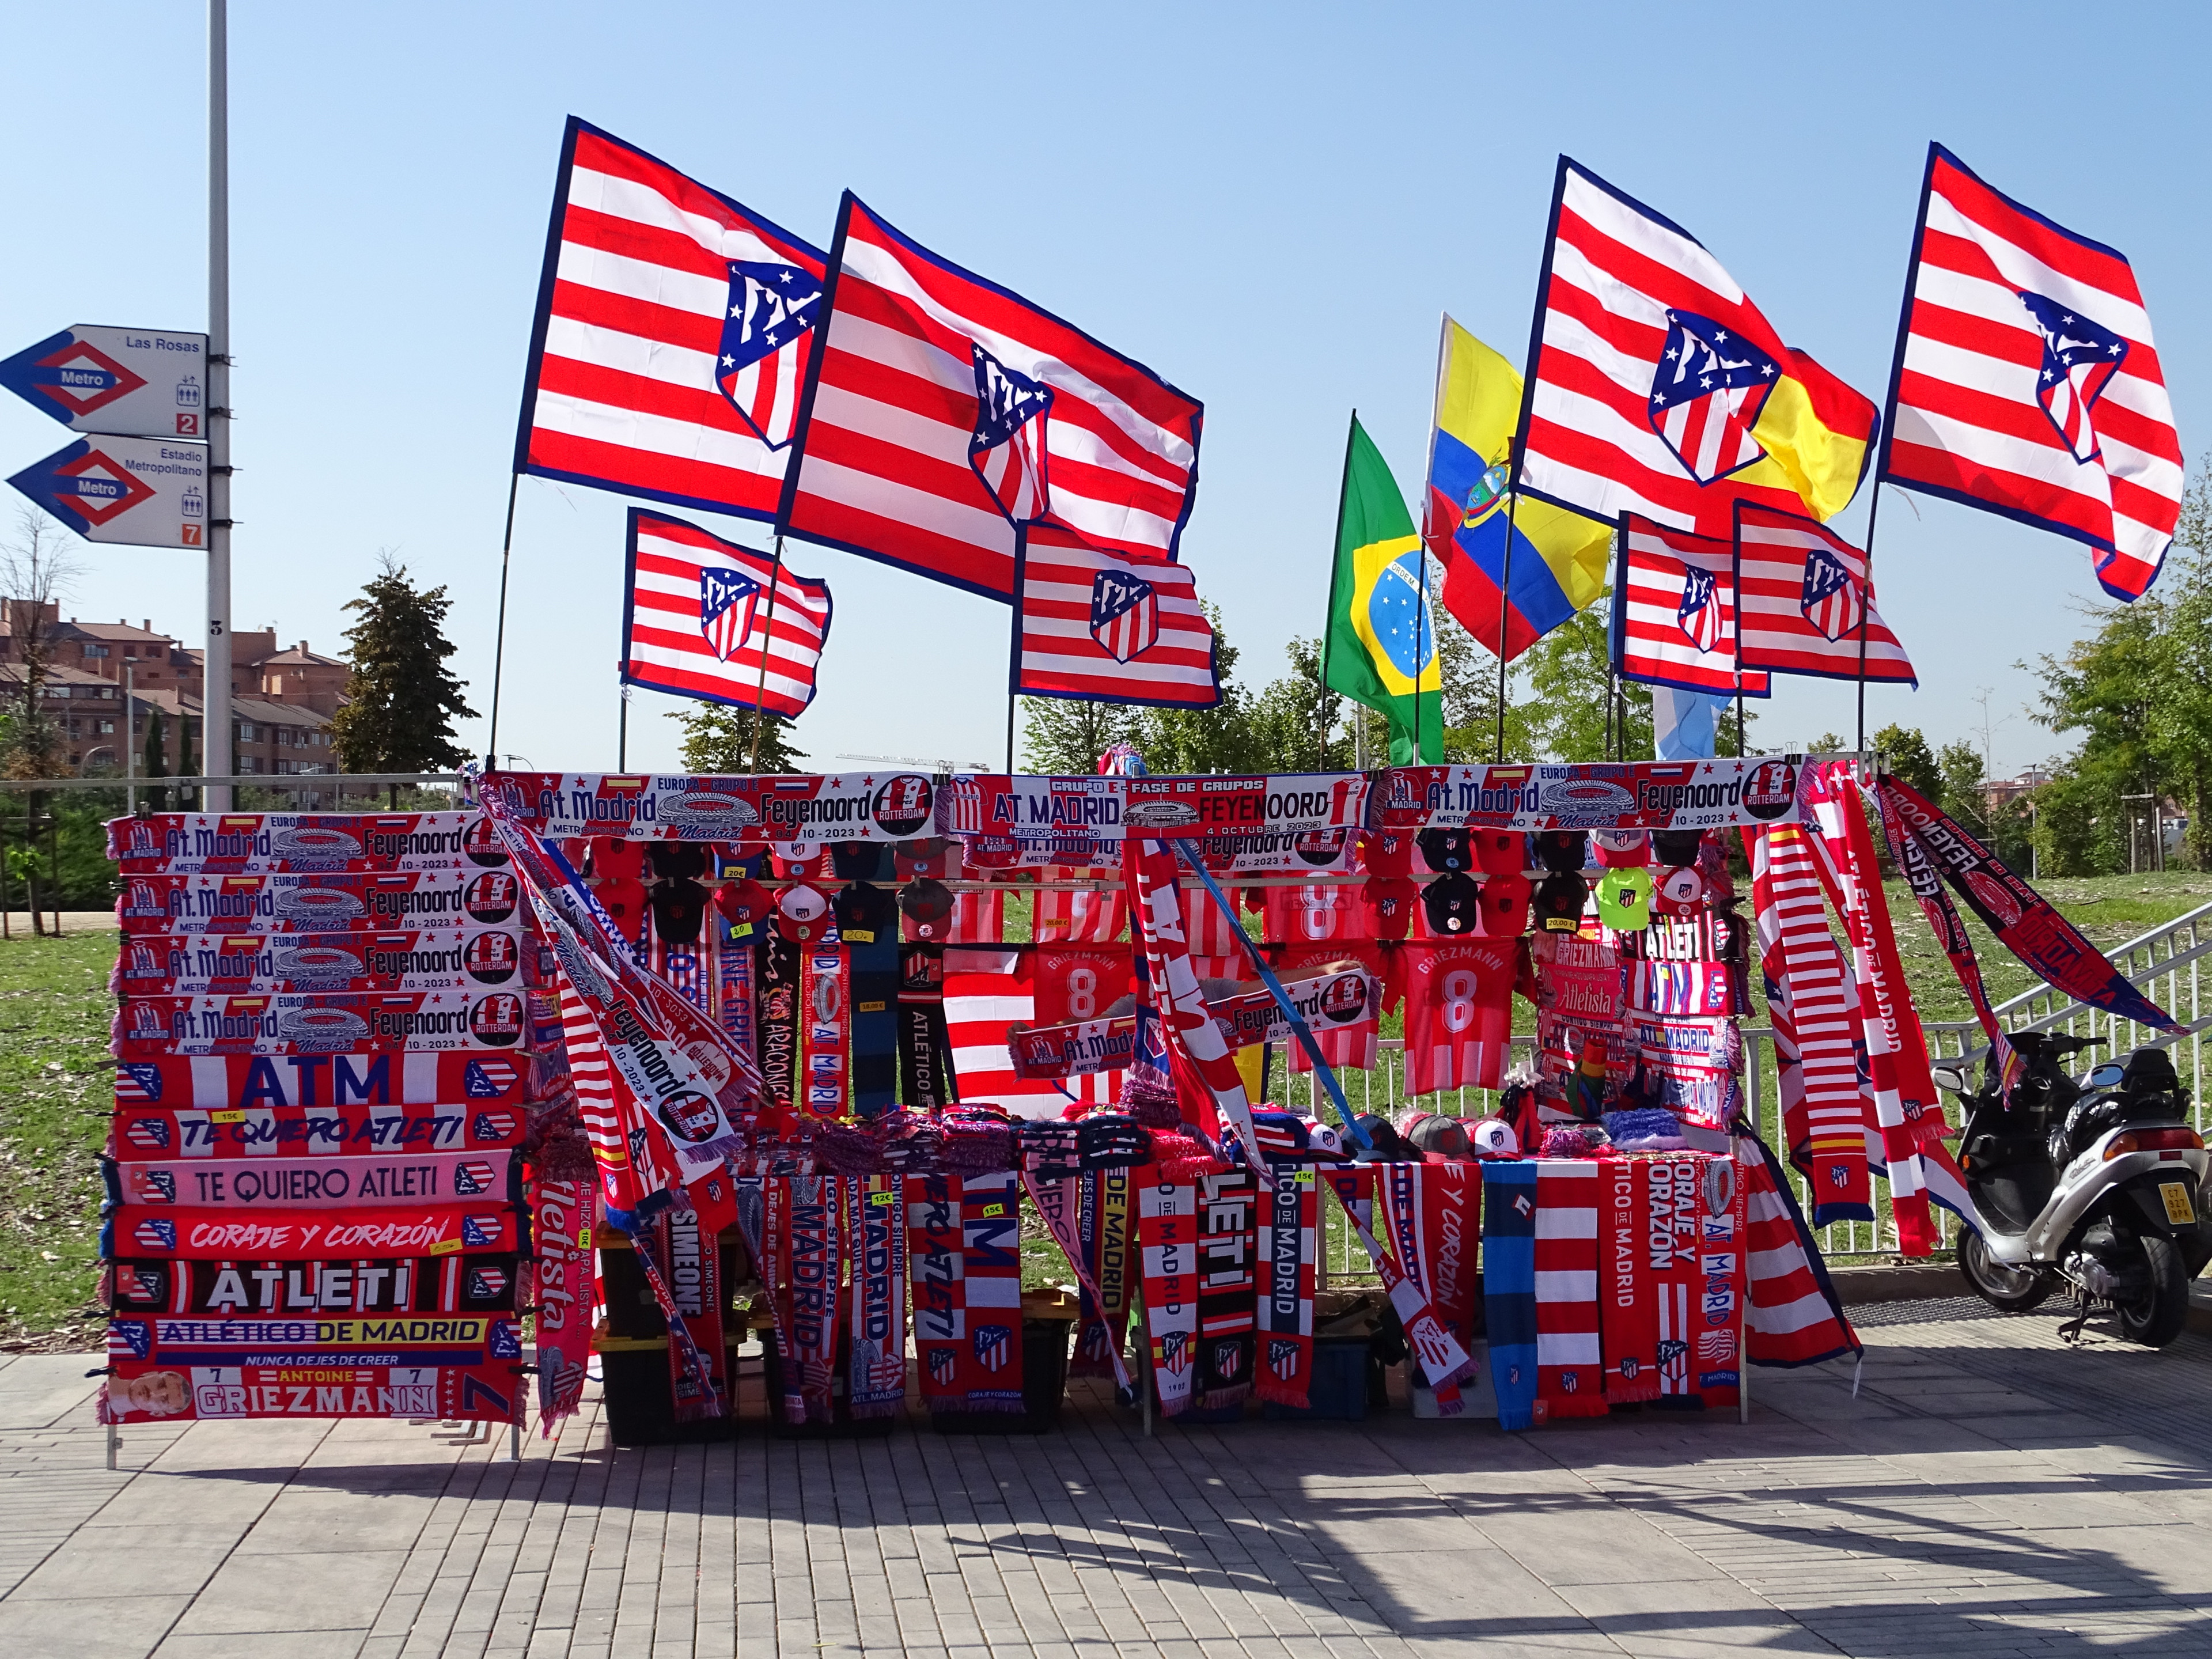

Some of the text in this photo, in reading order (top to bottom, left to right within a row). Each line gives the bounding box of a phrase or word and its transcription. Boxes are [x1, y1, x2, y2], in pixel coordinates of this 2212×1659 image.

[126, 336, 199, 353] Las Rosas
[62, 371, 104, 386] Metro
[181, 416, 194, 433] 2
[126, 460, 202, 478] Metropolitano
[161, 448, 202, 462] Estadio
[78, 480, 116, 495] Metro
[186, 527, 198, 543] 7
[1392, 563, 1415, 586] ORDEM
[658, 778, 748, 791] EUROPA GRUPO
[1052, 779, 1264, 794] GRUPO E FASE DE GRUPOS
[1540, 767, 1624, 779] EUROPA GRUPO
[540, 790, 871, 829] At. Madrid Feyenoord
[993, 794, 1120, 825] AT. MADRID
[1199, 791, 1329, 822] FEYENOORD
[1426, 776, 1742, 816] At. Madrid Feyenoord
[1747, 793, 1790, 805] ROTTERDAM
[271, 817, 309, 827] EUROPA
[878, 808, 925, 820] ROTTERDAM
[1207, 821, 1321, 835] 4 OCTUBRE 2023
[1437, 815, 1526, 827] METROPOLITANO
[1556, 813, 1619, 828] Madrid
[166, 826, 463, 861] At. Madrid Feyenoord
[553, 824, 644, 836] METROPOLITANO
[676, 824, 743, 839] Madrid
[1009, 828, 1101, 838] METROPOLITANO
[503, 825, 558, 900] METROPOLITANO
[976, 843, 1013, 853] AT. MADRID
[1026, 855, 1104, 865] METROPOLITANO
[1300, 842, 1339, 853] ROTTERDAM
[169, 884, 464, 921] At. Madrid Feyenoord
[470, 900, 512, 911] ROTTERDAM
[179, 923, 263, 932] METROPOLITANO
[734, 925, 745, 935] 20
[1646, 922, 1700, 959] ATLETI
[471, 960, 512, 971] ROTTERDAM
[1047, 951, 1118, 971] GRIEZMANN
[1417, 946, 1503, 975] GRIEZMANN
[1847, 850, 1902, 1053] ATLÉTICO DE MADRID
[554, 939, 595, 998] Madrid
[1067, 968, 1097, 1018] 8
[1326, 999, 1362, 1012] ROTTERDAM
[1441, 969, 1478, 1033] 8
[1558, 981, 1611, 1014] Atletista
[173, 1005, 469, 1041] At. Madrid Feyenoord
[476, 1022, 518, 1033] ROTTERDAM
[609, 998, 686, 1097] Feyenoord
[912, 1010, 932, 1090] ATLÉTICO
[1664, 1026, 1710, 1053] MADRID
[241, 1056, 389, 1107] ATM
[812, 1028, 839, 1115] AT. MADRID
[180, 1116, 464, 1147] TE QUIERO ATLETI
[664, 1101, 695, 1140] ROTTERDAM
[195, 1166, 437, 1203] TE QUIERO ATLETI
[1297, 1172, 1313, 1181] 15€
[874, 1194, 891, 1203] 12€
[984, 1205, 1001, 1215] 15€
[1734, 1192, 1744, 1233] SIEMPRE
[580, 1200, 591, 1230] HIZO
[1081, 1210, 1092, 1243] CREER
[191, 1215, 450, 1251] CORAJE Y CORAZÓN
[581, 1231, 589, 1246] 10€
[850, 1210, 866, 1284] MÁS QUE TÚ
[1102, 1175, 1127, 1309] DE MADRID
[540, 1181, 576, 1329] tletista
[671, 1209, 702, 1316] SIMEONE
[892, 1227, 903, 1277] SIEMPRE
[1277, 1210, 1296, 1315] DE MADRID
[1436, 1187, 1465, 1310] Y CORAZÓN
[790, 1205, 825, 1349] MADRID
[824, 1226, 838, 1319] SIEMPRE
[863, 1190, 890, 1341] MADRID
[1159, 1222, 1181, 1316] MADRID
[1615, 1228, 1635, 1308] MADRID
[1704, 1223, 1733, 1327] AT. MADRID
[206, 1267, 410, 1308] ATLETI
[579, 1282, 590, 1316] LISTA
[704, 1259, 715, 1313] SIMEONE!
[924, 1238, 955, 1339] ATLETI
[161, 1319, 479, 1342] ATLÉTICO DE MADRID
[245, 1354, 399, 1366] NUNCA DEJES DE CREER
[209, 1369, 421, 1384] 7 ANTOINE 7
[1707, 1372, 1736, 1381] MADRID
[199, 1372, 510, 1415] GRIEZMANN 7
[870, 1388, 904, 1402] MADRID
[968, 1391, 990, 1399] CORAJE
